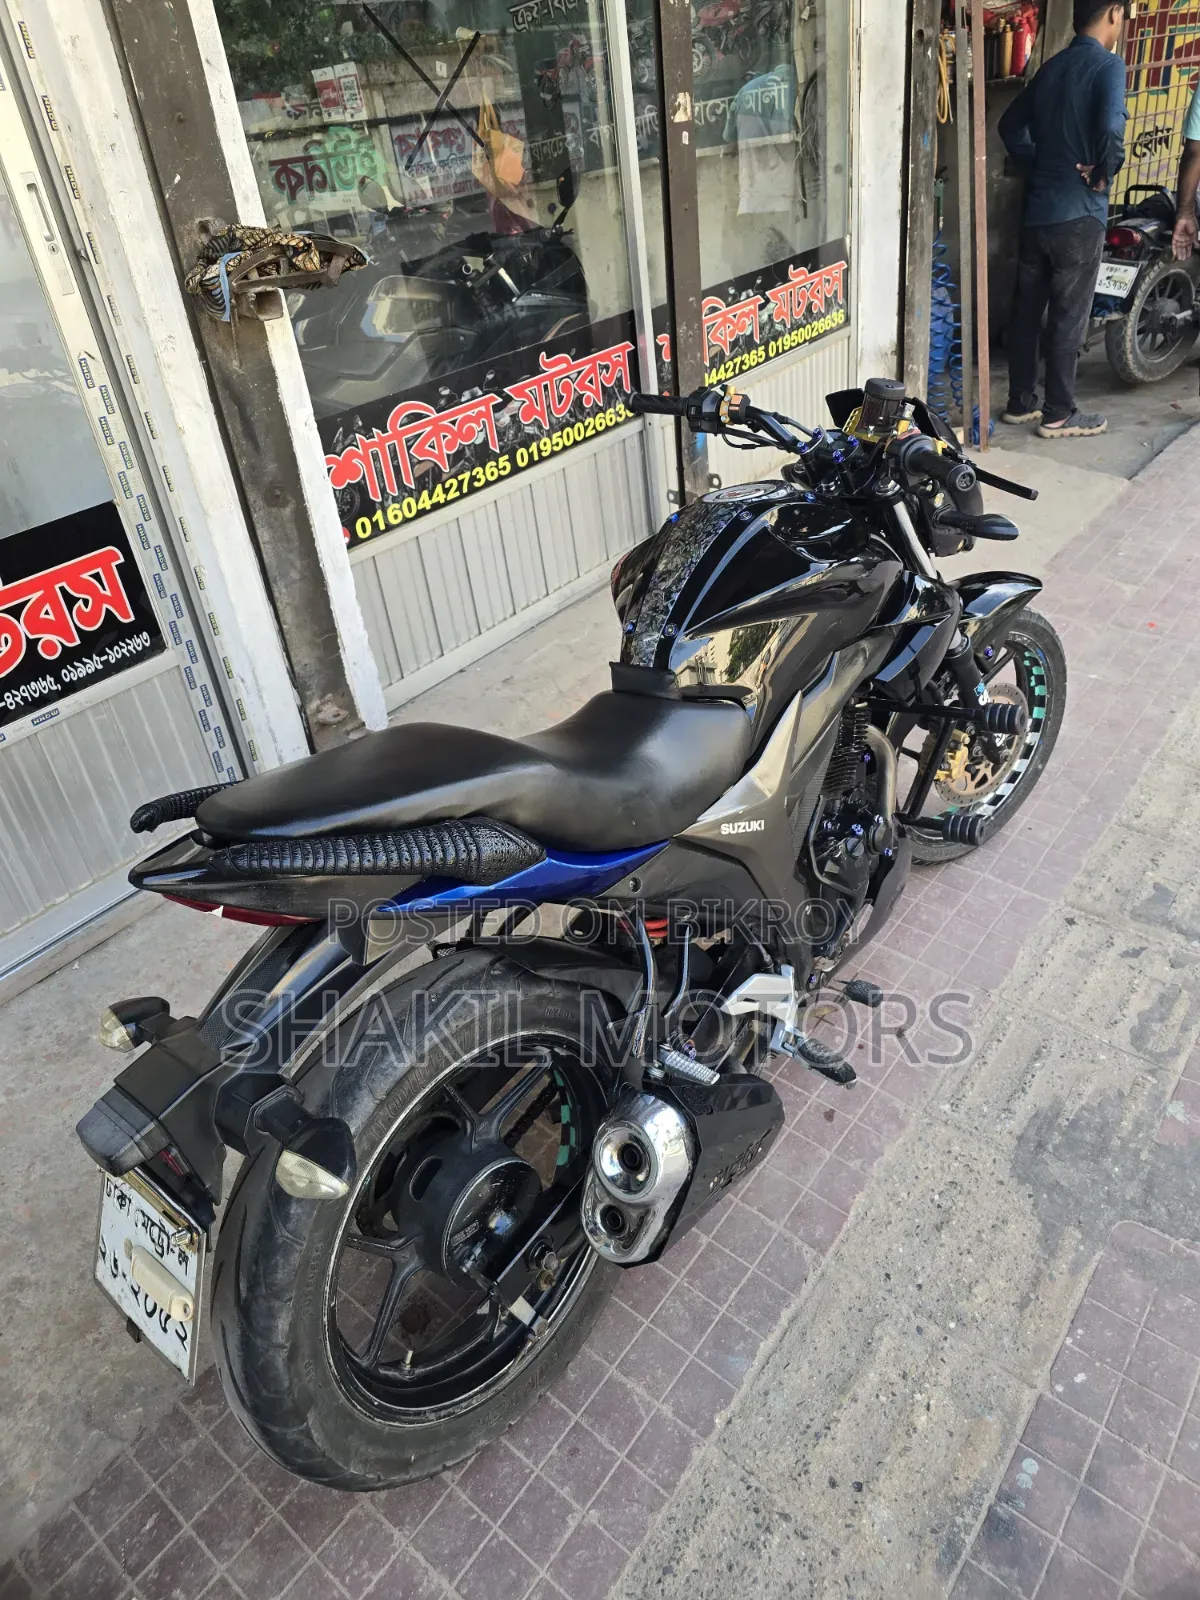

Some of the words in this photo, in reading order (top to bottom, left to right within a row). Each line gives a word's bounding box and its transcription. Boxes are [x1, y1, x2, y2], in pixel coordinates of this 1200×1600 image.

[765, 260, 848, 329] মটরস
[768, 308, 845, 358] 01950026636
[324, 400, 503, 502] শাকিল
[503, 340, 636, 430] মটরস
[355, 454, 512, 540] 01604427365
[720, 819, 765, 835] SUZUKI
